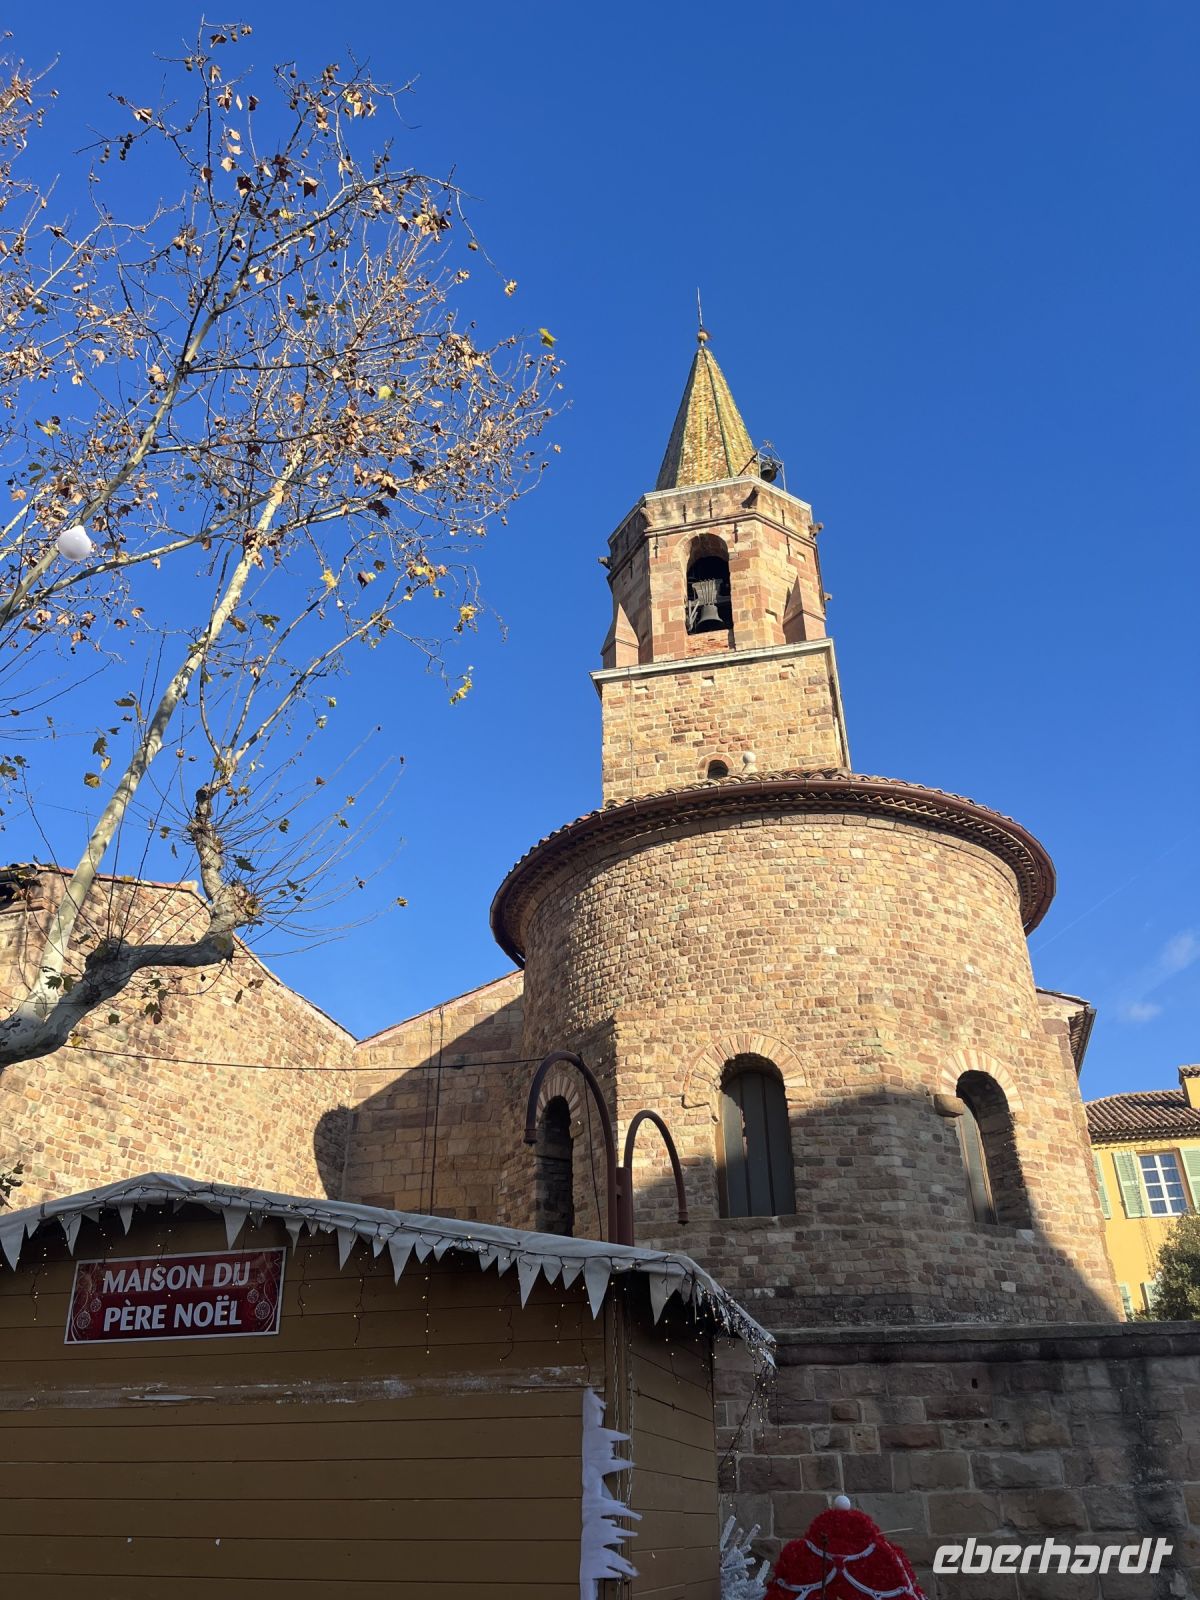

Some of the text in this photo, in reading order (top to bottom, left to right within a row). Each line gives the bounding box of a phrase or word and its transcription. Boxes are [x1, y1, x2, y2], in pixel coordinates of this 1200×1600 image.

[103, 1261, 251, 1293] MAISON DU
[103, 1295, 242, 1331] PÈRE NOËL
